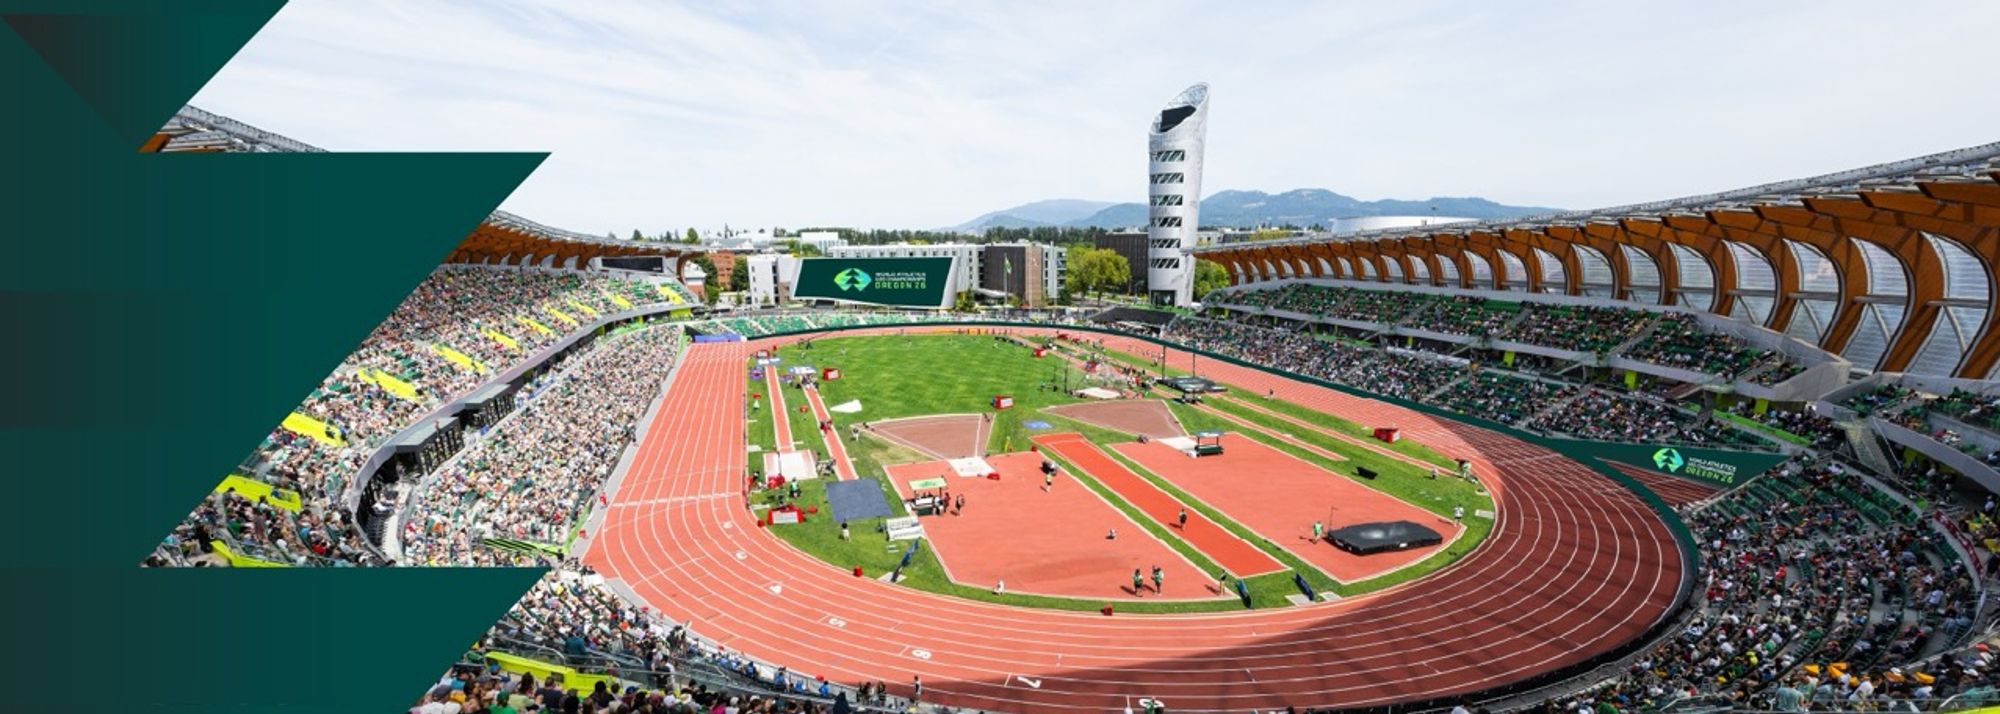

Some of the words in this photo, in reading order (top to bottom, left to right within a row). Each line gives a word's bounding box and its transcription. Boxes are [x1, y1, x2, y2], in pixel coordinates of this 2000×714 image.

[1707, 460, 1736, 473] ATHLETICS
[1685, 466, 1719, 480] OREGON
[1720, 474, 1734, 484] 26
